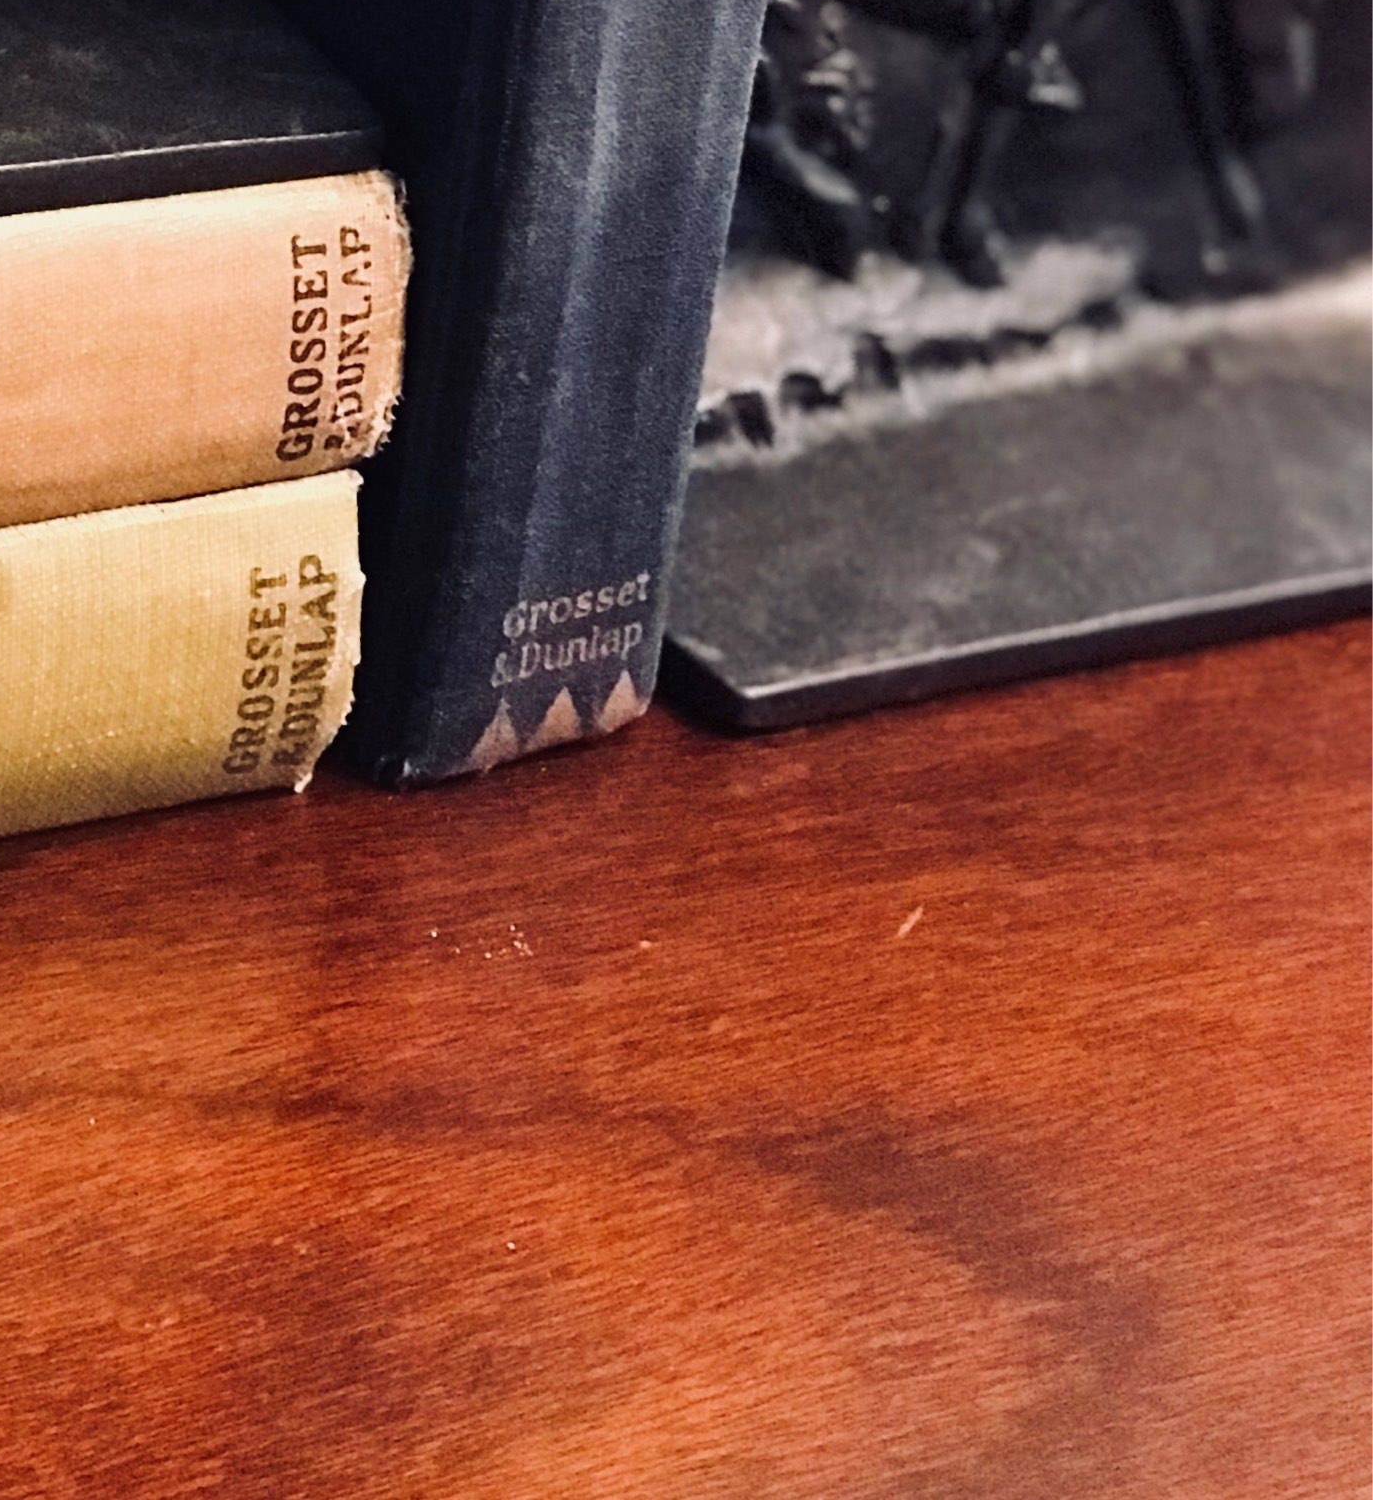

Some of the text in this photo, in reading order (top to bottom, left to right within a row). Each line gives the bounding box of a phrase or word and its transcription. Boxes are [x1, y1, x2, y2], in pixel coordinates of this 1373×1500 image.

[276, 234, 328, 461] GROSSET
[222, 567, 287, 774] GROSSET
[503, 569, 650, 638] Grosset
